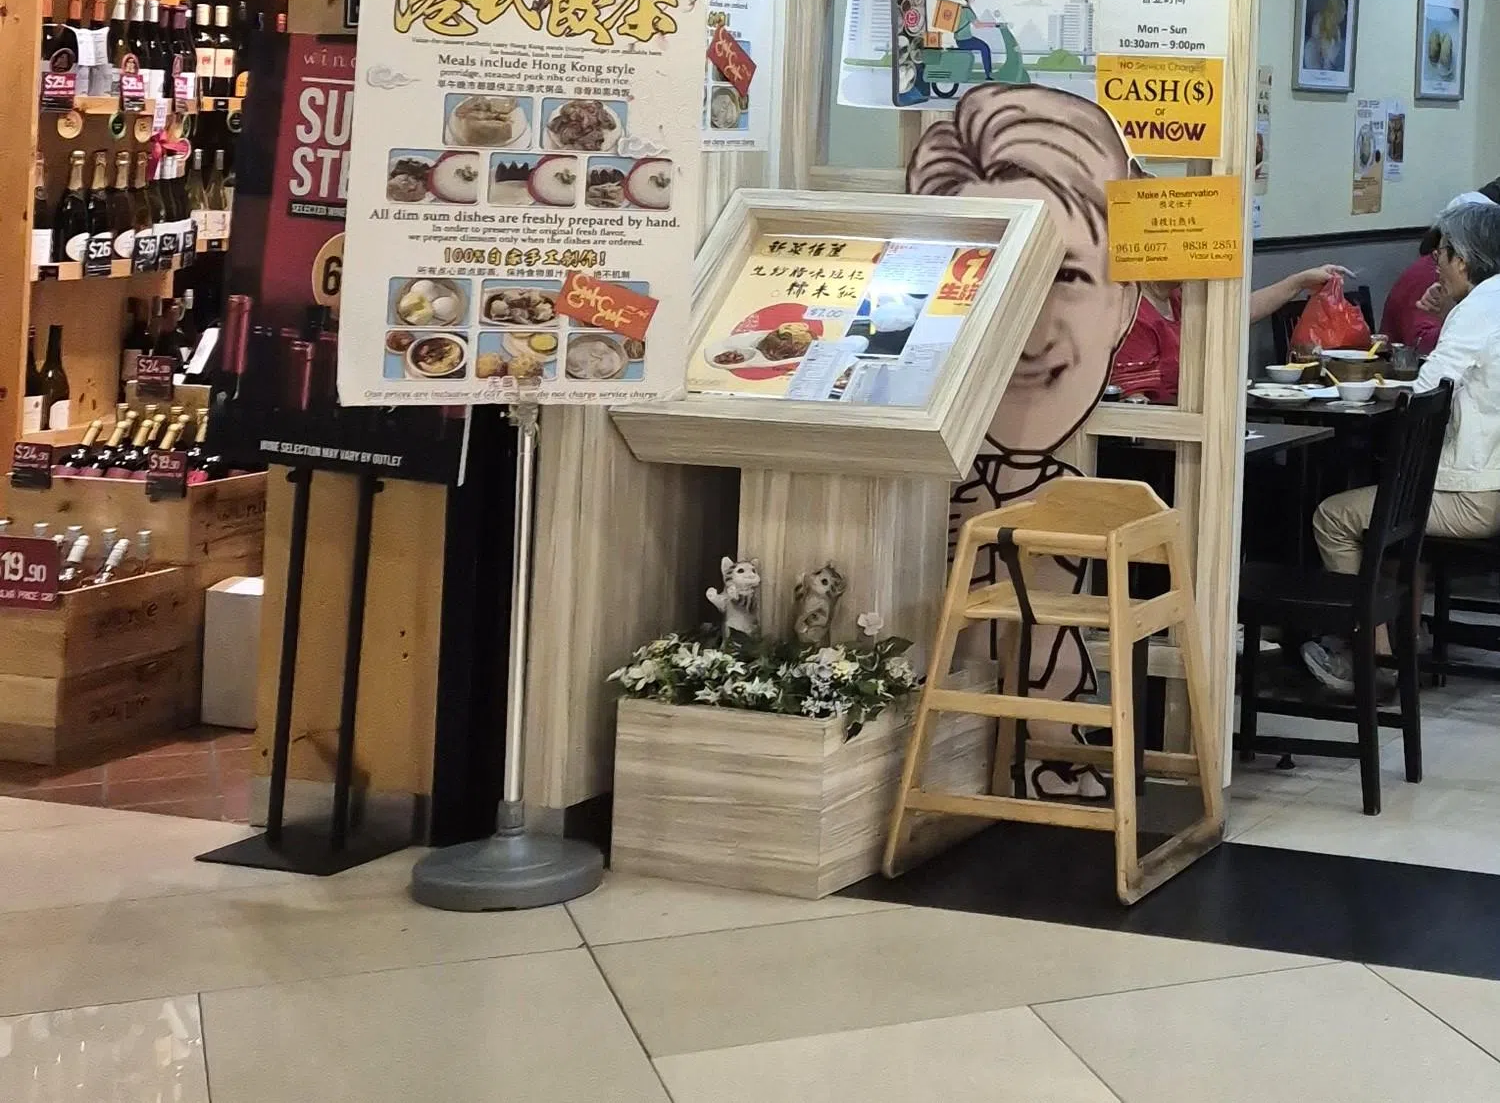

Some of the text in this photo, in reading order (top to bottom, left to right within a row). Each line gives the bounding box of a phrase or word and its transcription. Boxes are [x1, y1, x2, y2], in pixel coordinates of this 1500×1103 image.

[1137, 24, 1188, 35] Mon Sun
[1119, 38, 1206, 51] 10:30am 9:00pm
[438, 54, 636, 78] Meals include Hong Kong style
[1120, 61, 1134, 70] NO
[1135, 61, 1166, 71] Service
[1104, 77, 1214, 105] CASH ($)
[1155, 107, 1166, 116] or
[1116, 120, 1207, 142] AYNOW
[1136, 188, 1219, 199] Make A Reservation
[369, 208, 681, 229] All dim sum dishes are freshly prepared by hand.
[88, 240, 112, 259] $26
[280, 442, 321, 457] SELECTION
[340, 449, 361, 462] VARY
[372, 453, 402, 468] OUTLET
[0, 551, 47, 583] 19.90
